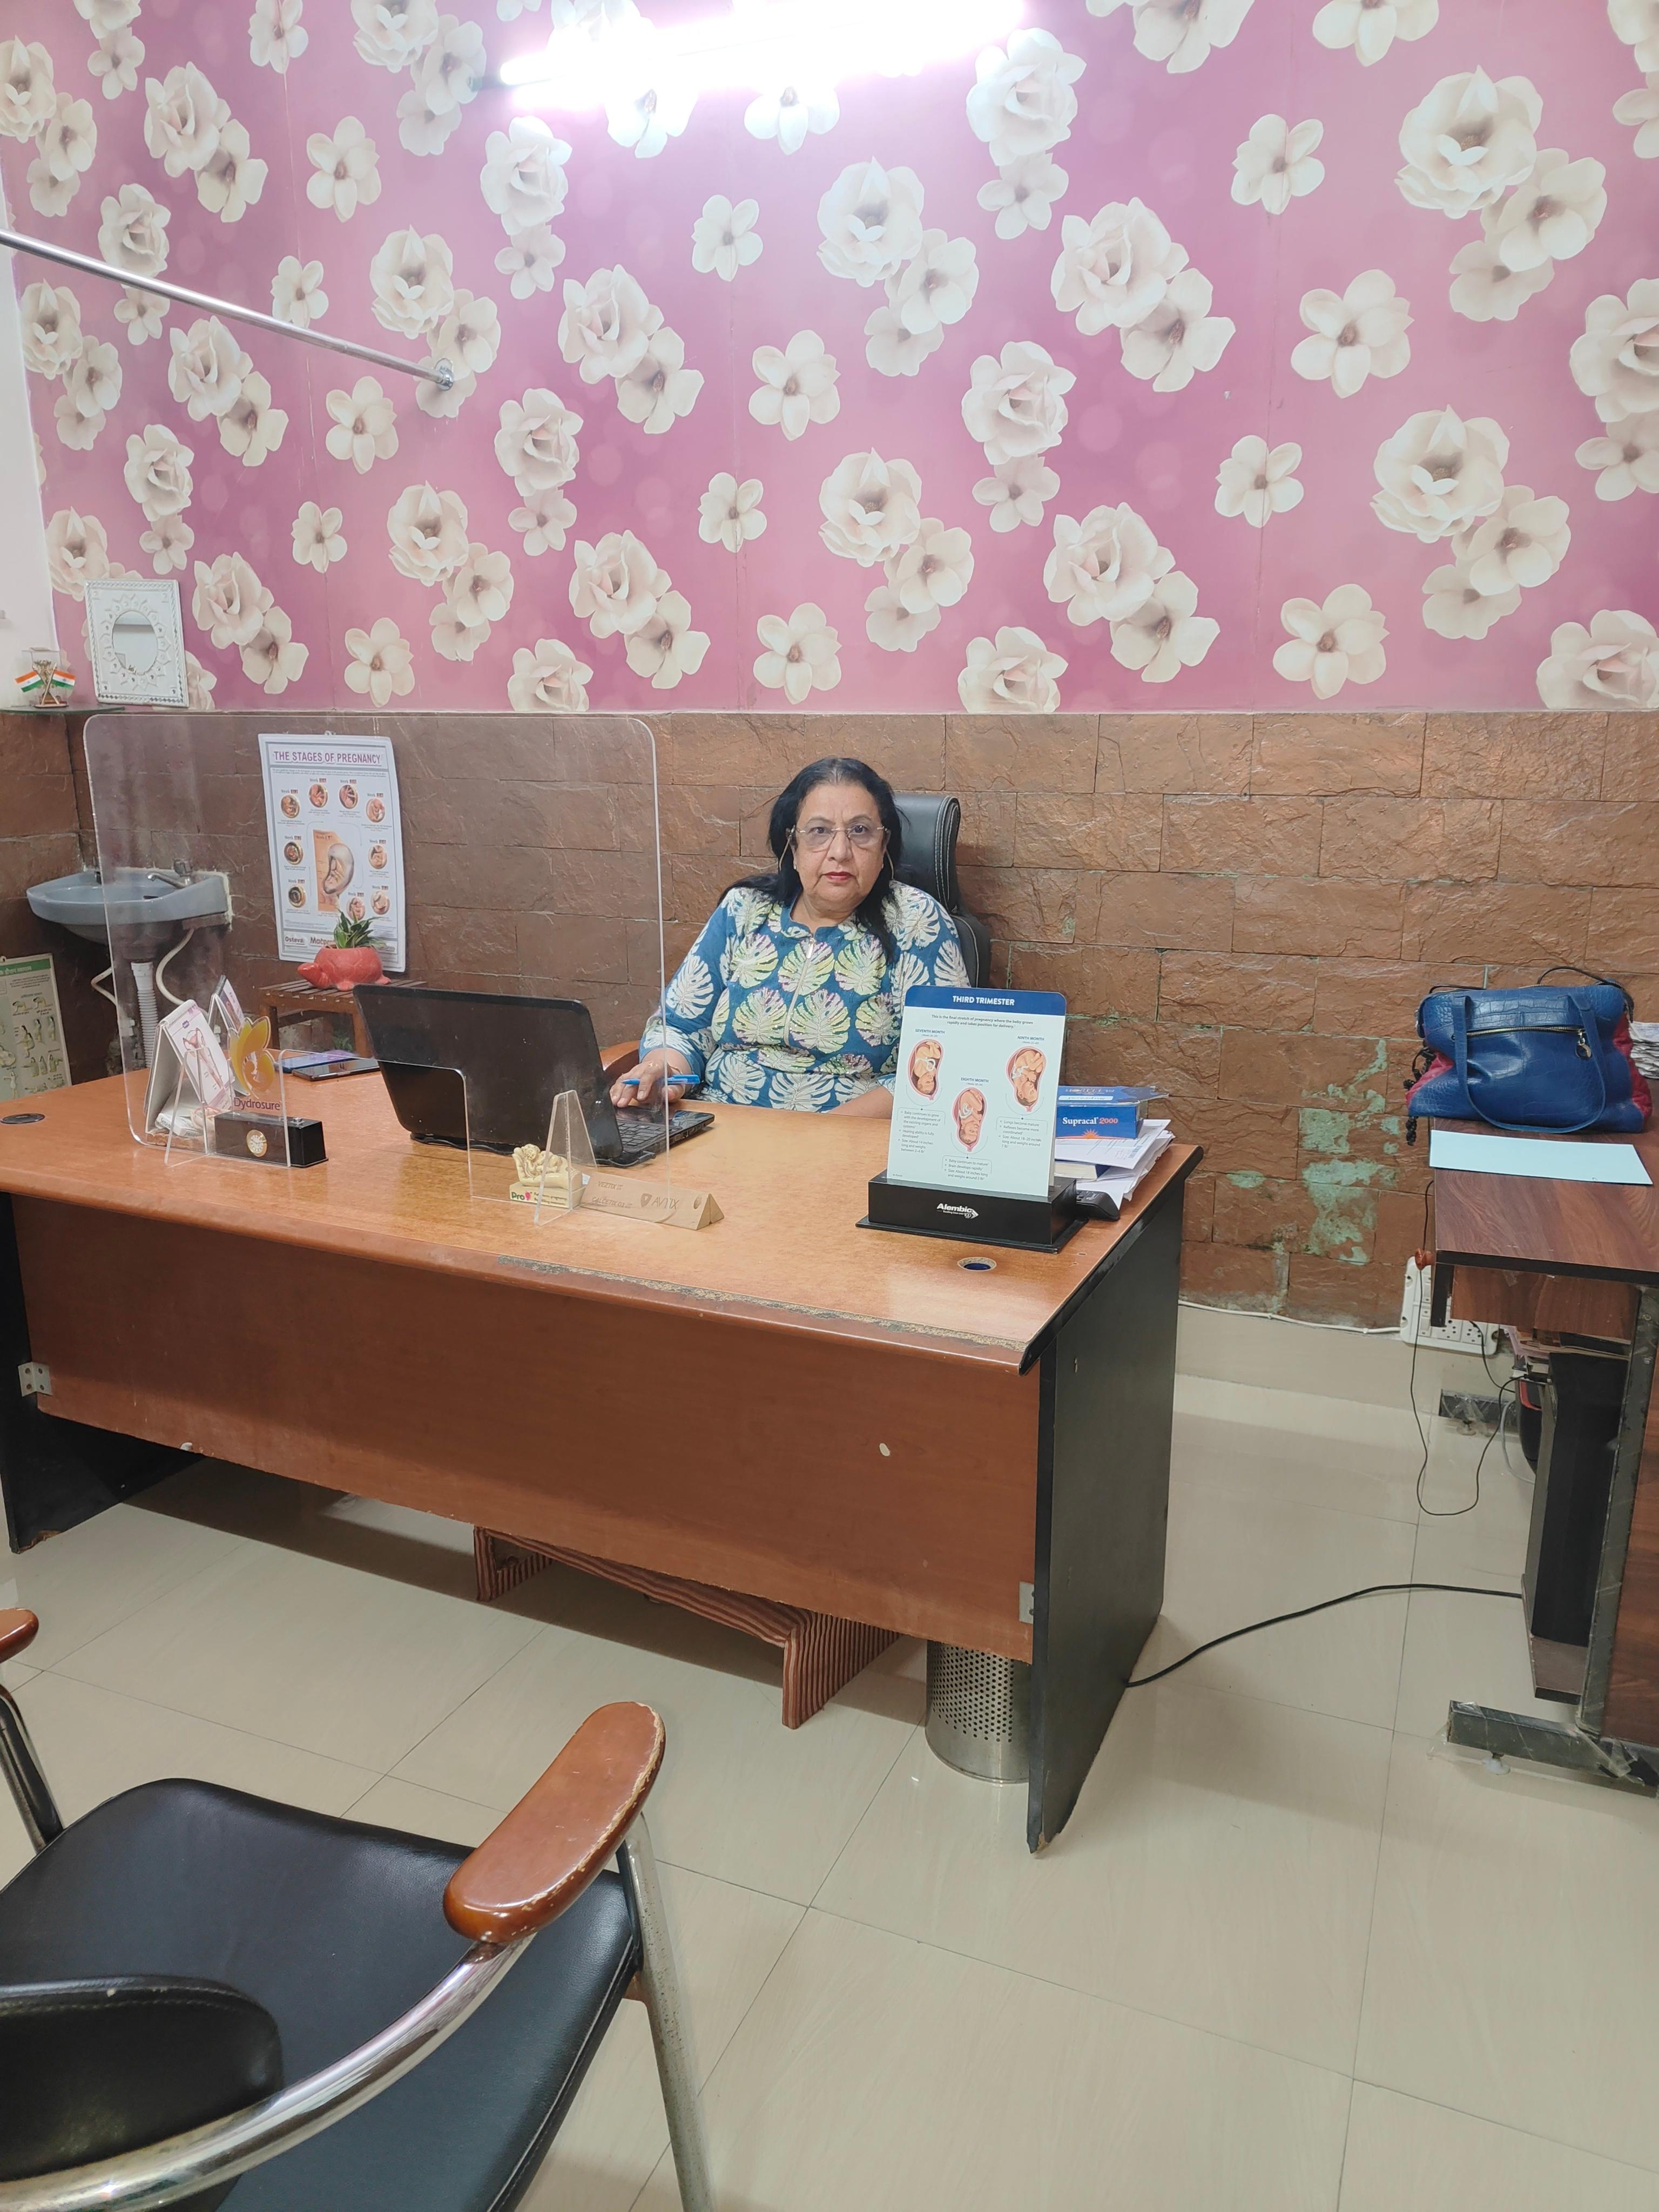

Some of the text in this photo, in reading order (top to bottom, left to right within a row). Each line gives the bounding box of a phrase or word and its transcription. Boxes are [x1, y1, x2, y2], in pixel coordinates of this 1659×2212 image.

[274, 751, 380, 764] THE STAGES OF PREGNANCY
[953, 995, 1015, 1006] THIRD TRIMESTER
[234, 1097, 280, 1110] Dydrosure
[1062, 1117, 1097, 1127] Supracal
[598, 1181, 617, 1189] VEZTIX
[936, 1203, 972, 1213] Alembic
